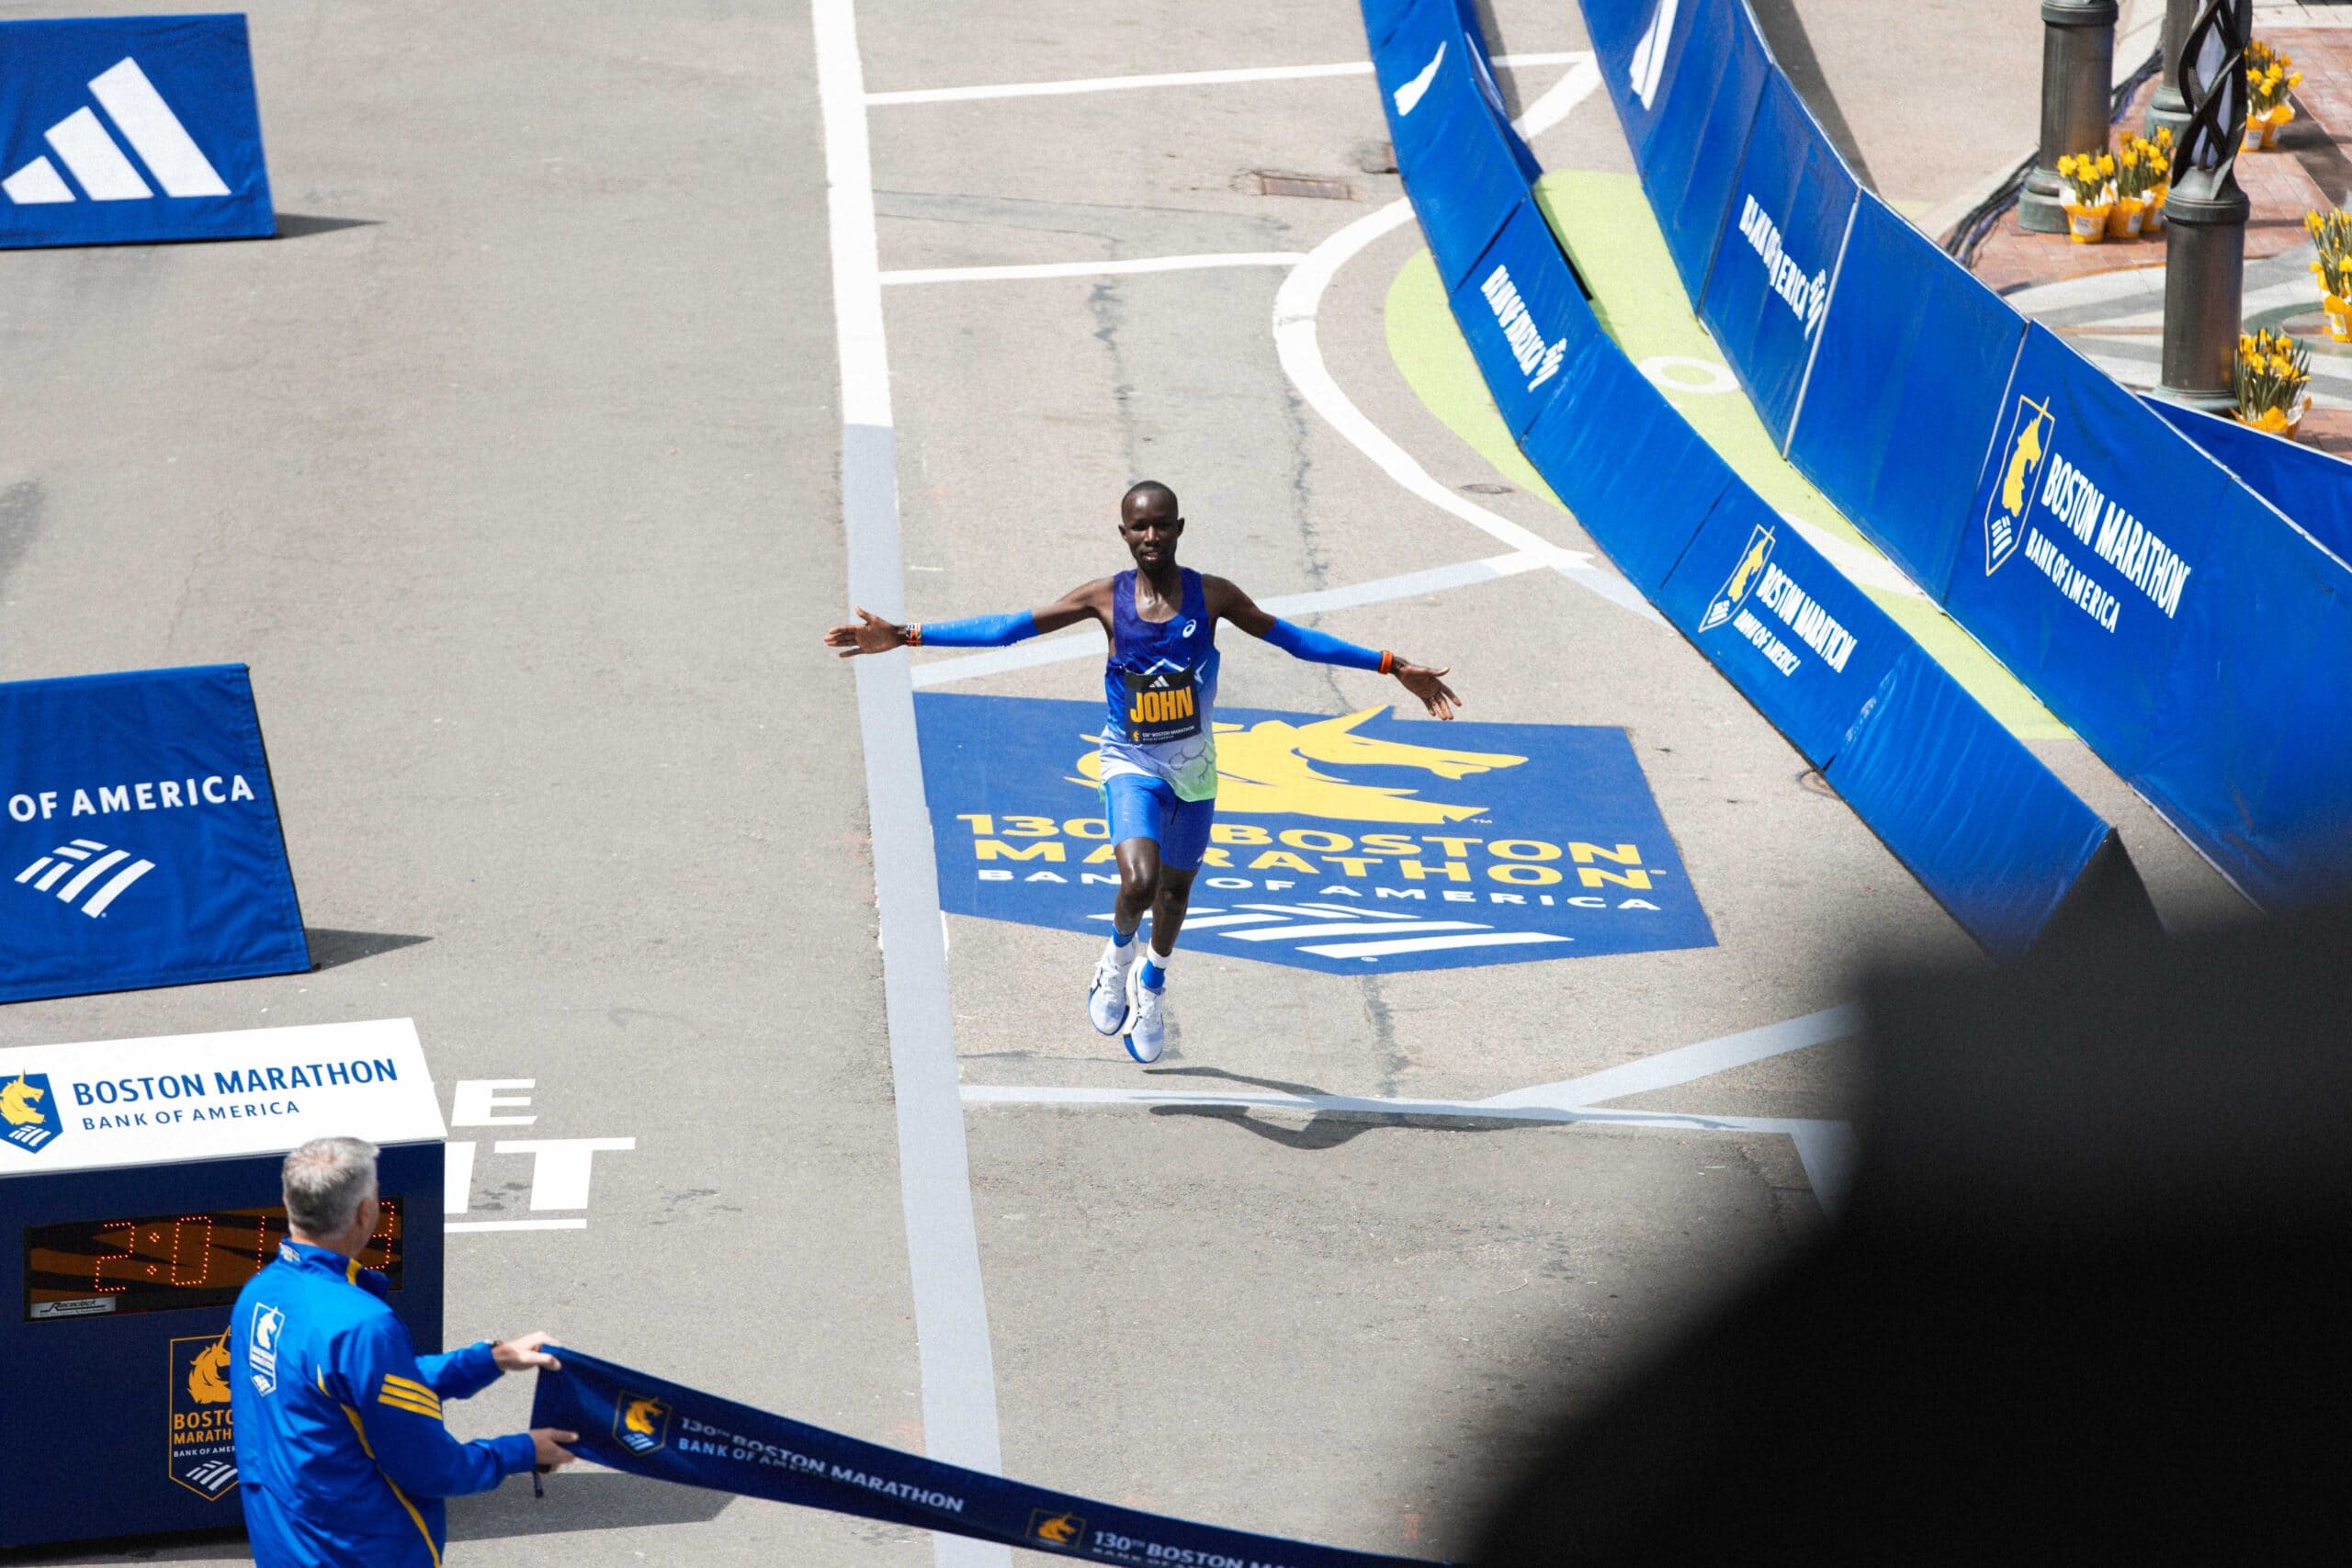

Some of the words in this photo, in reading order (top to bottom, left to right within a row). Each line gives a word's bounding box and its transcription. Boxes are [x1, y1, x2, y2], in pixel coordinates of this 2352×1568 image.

[2024, 527, 2059, 577] BANK
[2041, 452, 2106, 547] BOSTON
[2094, 501, 2190, 619] MARATHON
[2052, 553, 2071, 588] OF
[1756, 561, 1806, 626] BOSTON
[1792, 595, 1858, 673] MARATHON
[2061, 565, 2121, 634] AMERICA
[1129, 685, 1194, 724] JOHN
[8, 794, 58, 822] OF
[71, 774, 255, 817] AMERICA
[1209, 823, 1643, 865] BOSTON
[978, 869, 1122, 885] BAN
[1205, 877, 1296, 891] OF
[1319, 885, 1662, 911] AMERICA
[73, 1073, 206, 1106] BOSTON
[215, 1057, 398, 1095] MARATHON
[82, 1112, 148, 1131] BANK
[155, 1110, 184, 1126] OF
[192, 1100, 300, 1122] AMERICA
[174, 1409, 233, 1430] BOSTO
[174, 1428, 232, 1445] MARATH
[173, 1449, 198, 1458] BANK
[198, 1448, 212, 1456] OF
[212, 1446, 235, 1454] AMER
[678, 1438, 727, 1458] BANK
[731, 1447, 756, 1462] OF
[732, 1434, 826, 1472] BOSTON
[830, 1465, 965, 1513] MARATHON
[1147, 1543, 1244, 1568] BOSTON
